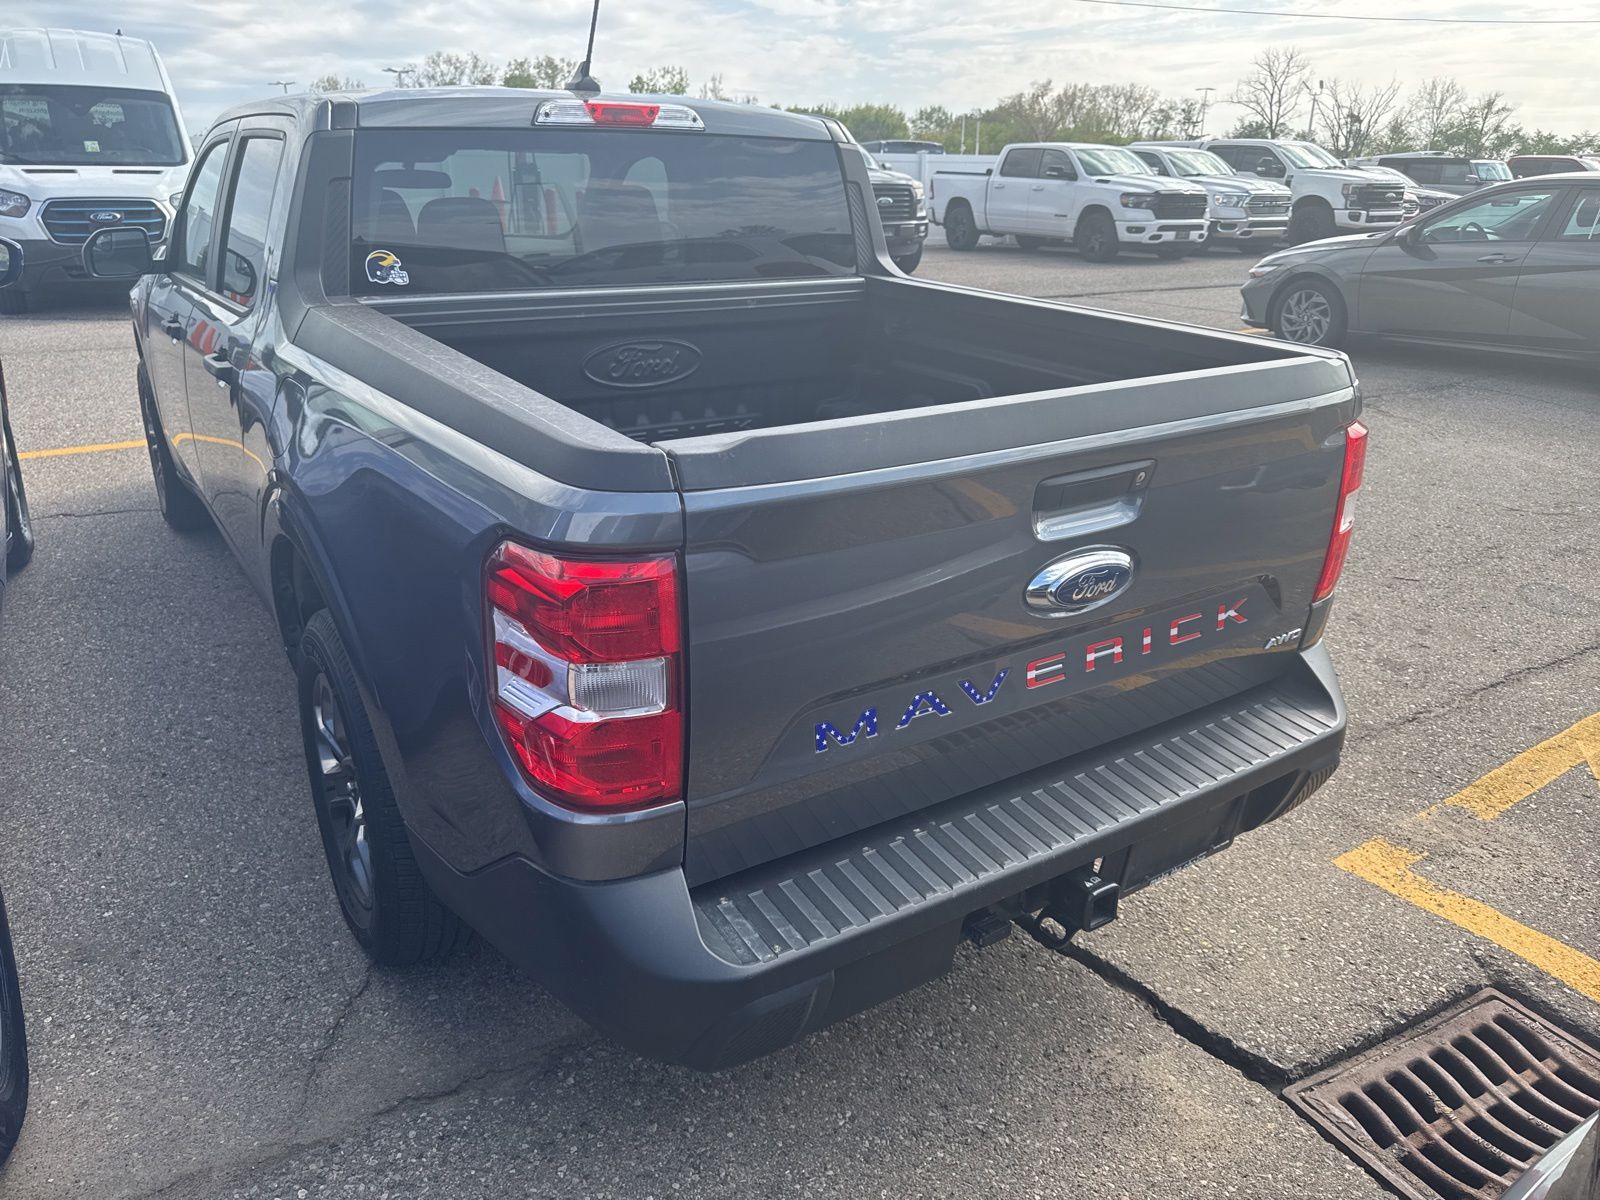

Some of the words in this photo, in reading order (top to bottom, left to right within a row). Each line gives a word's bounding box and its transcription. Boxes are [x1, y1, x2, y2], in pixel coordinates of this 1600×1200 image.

[609, 343, 680, 377] Ford
[1072, 569, 1119, 601] Ford
[1264, 628, 1302, 650] AWD
[814, 597, 1249, 754] MAVERICK
[1474, 1136, 1505, 1158] IRON
